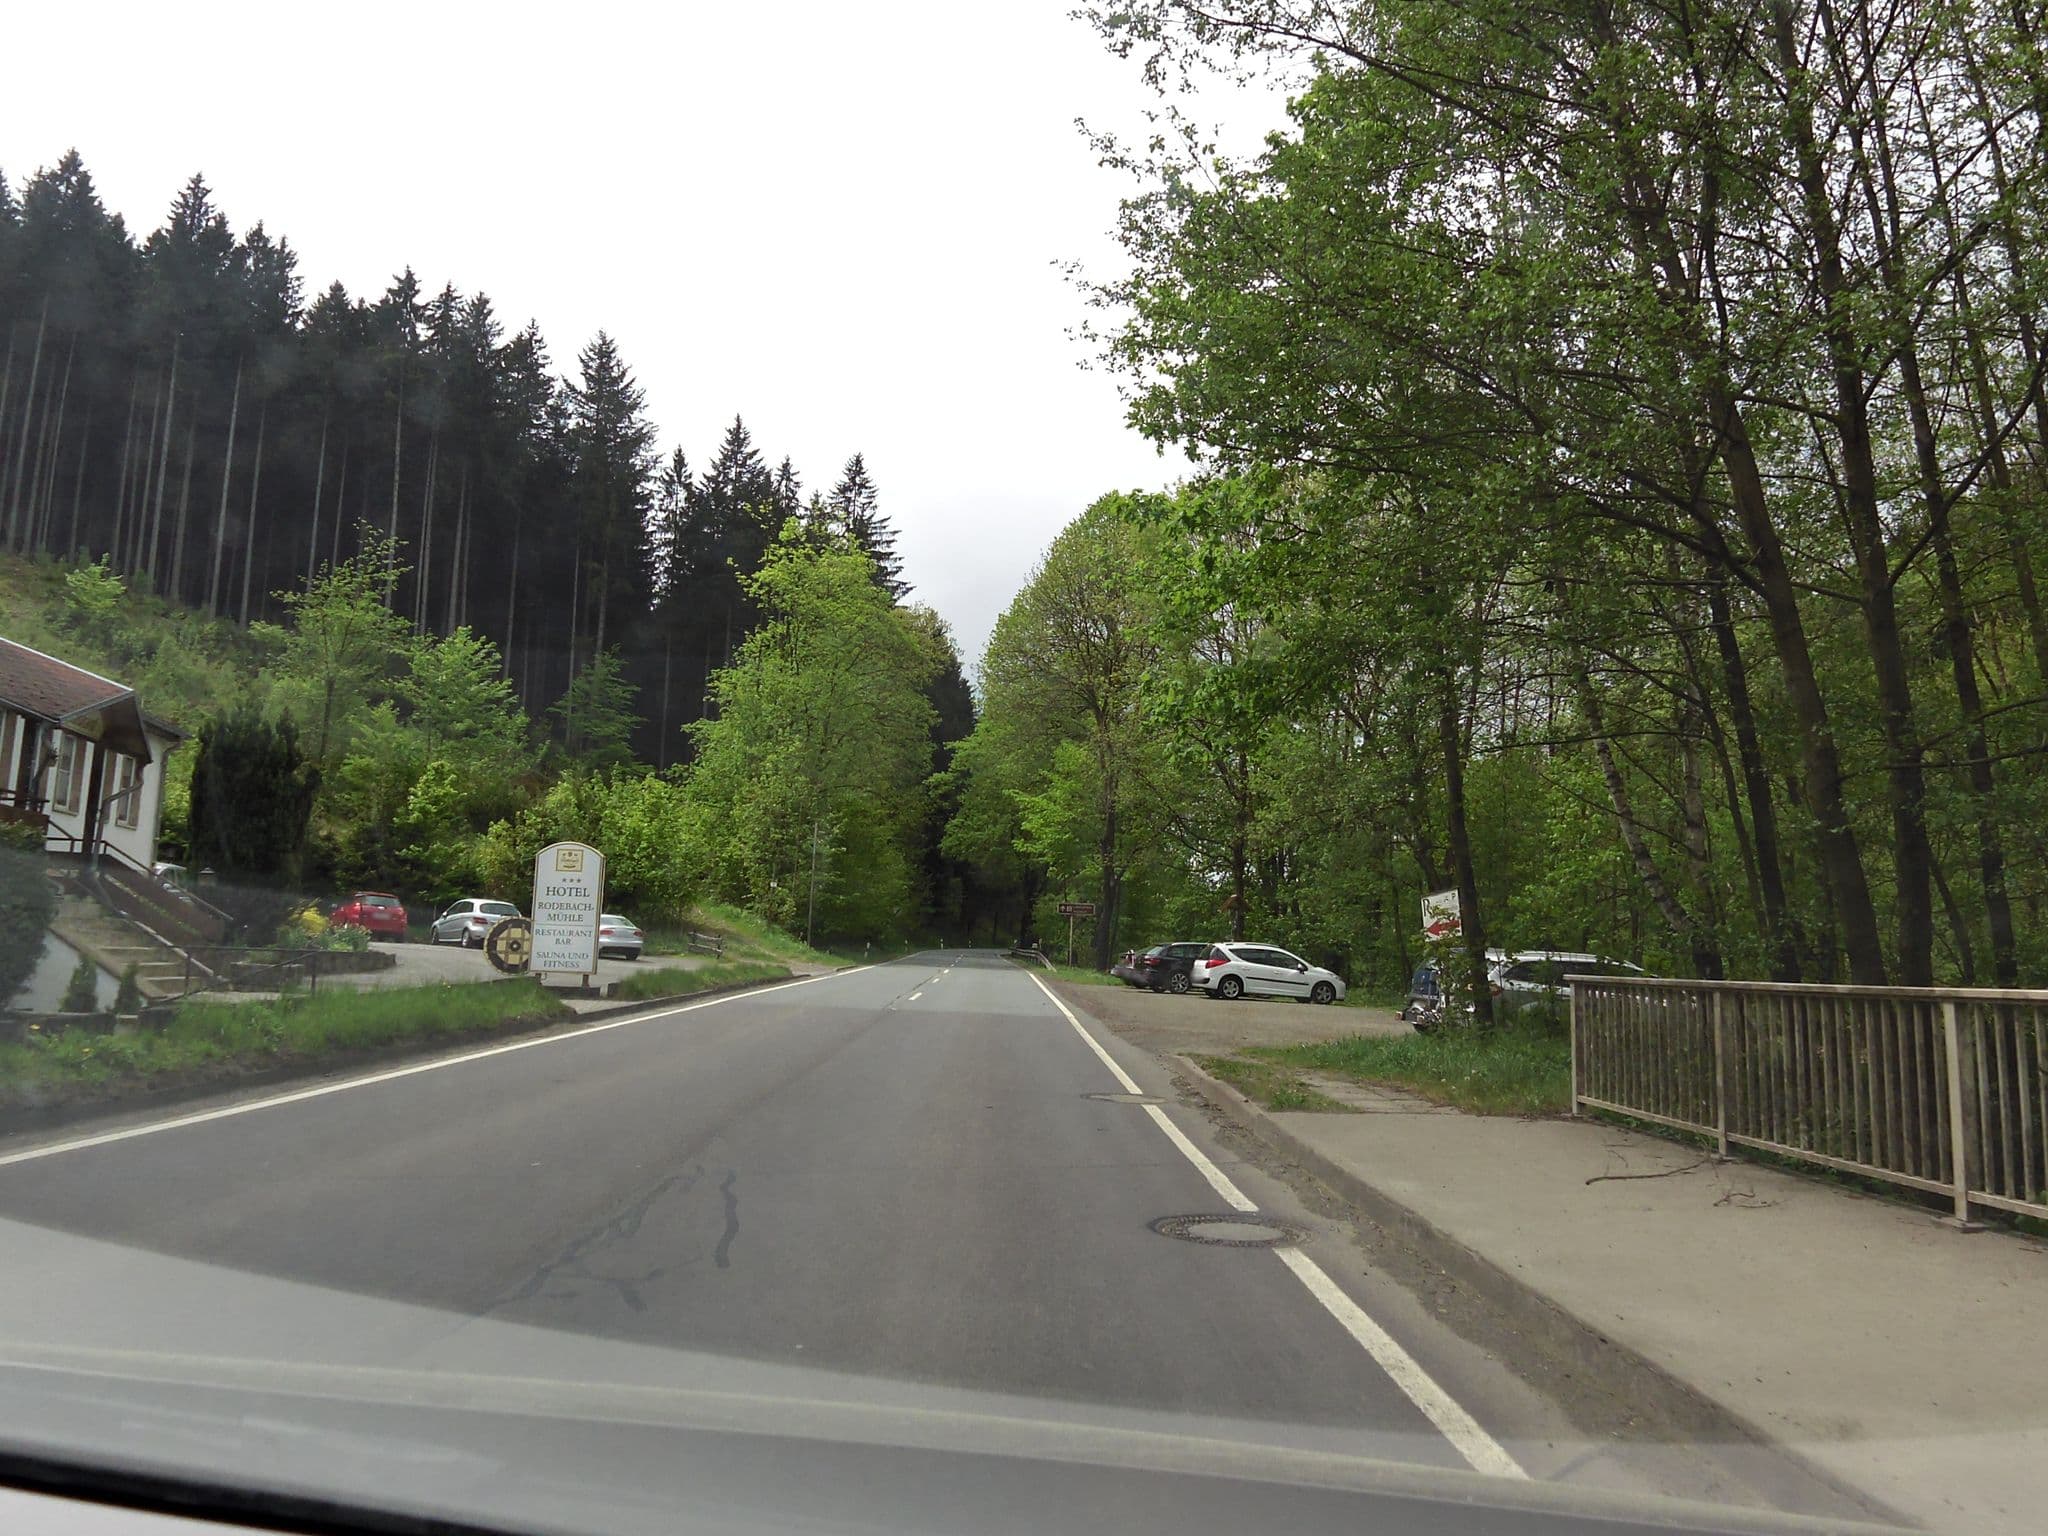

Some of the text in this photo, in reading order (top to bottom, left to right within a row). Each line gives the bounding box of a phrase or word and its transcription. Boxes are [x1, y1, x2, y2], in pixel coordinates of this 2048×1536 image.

[545, 886, 590, 898] HOTEL
[535, 928, 592, 938] RESTAURANT
[536, 951, 589, 960] SAUNA UND
[543, 960, 580, 968] FITNESS
